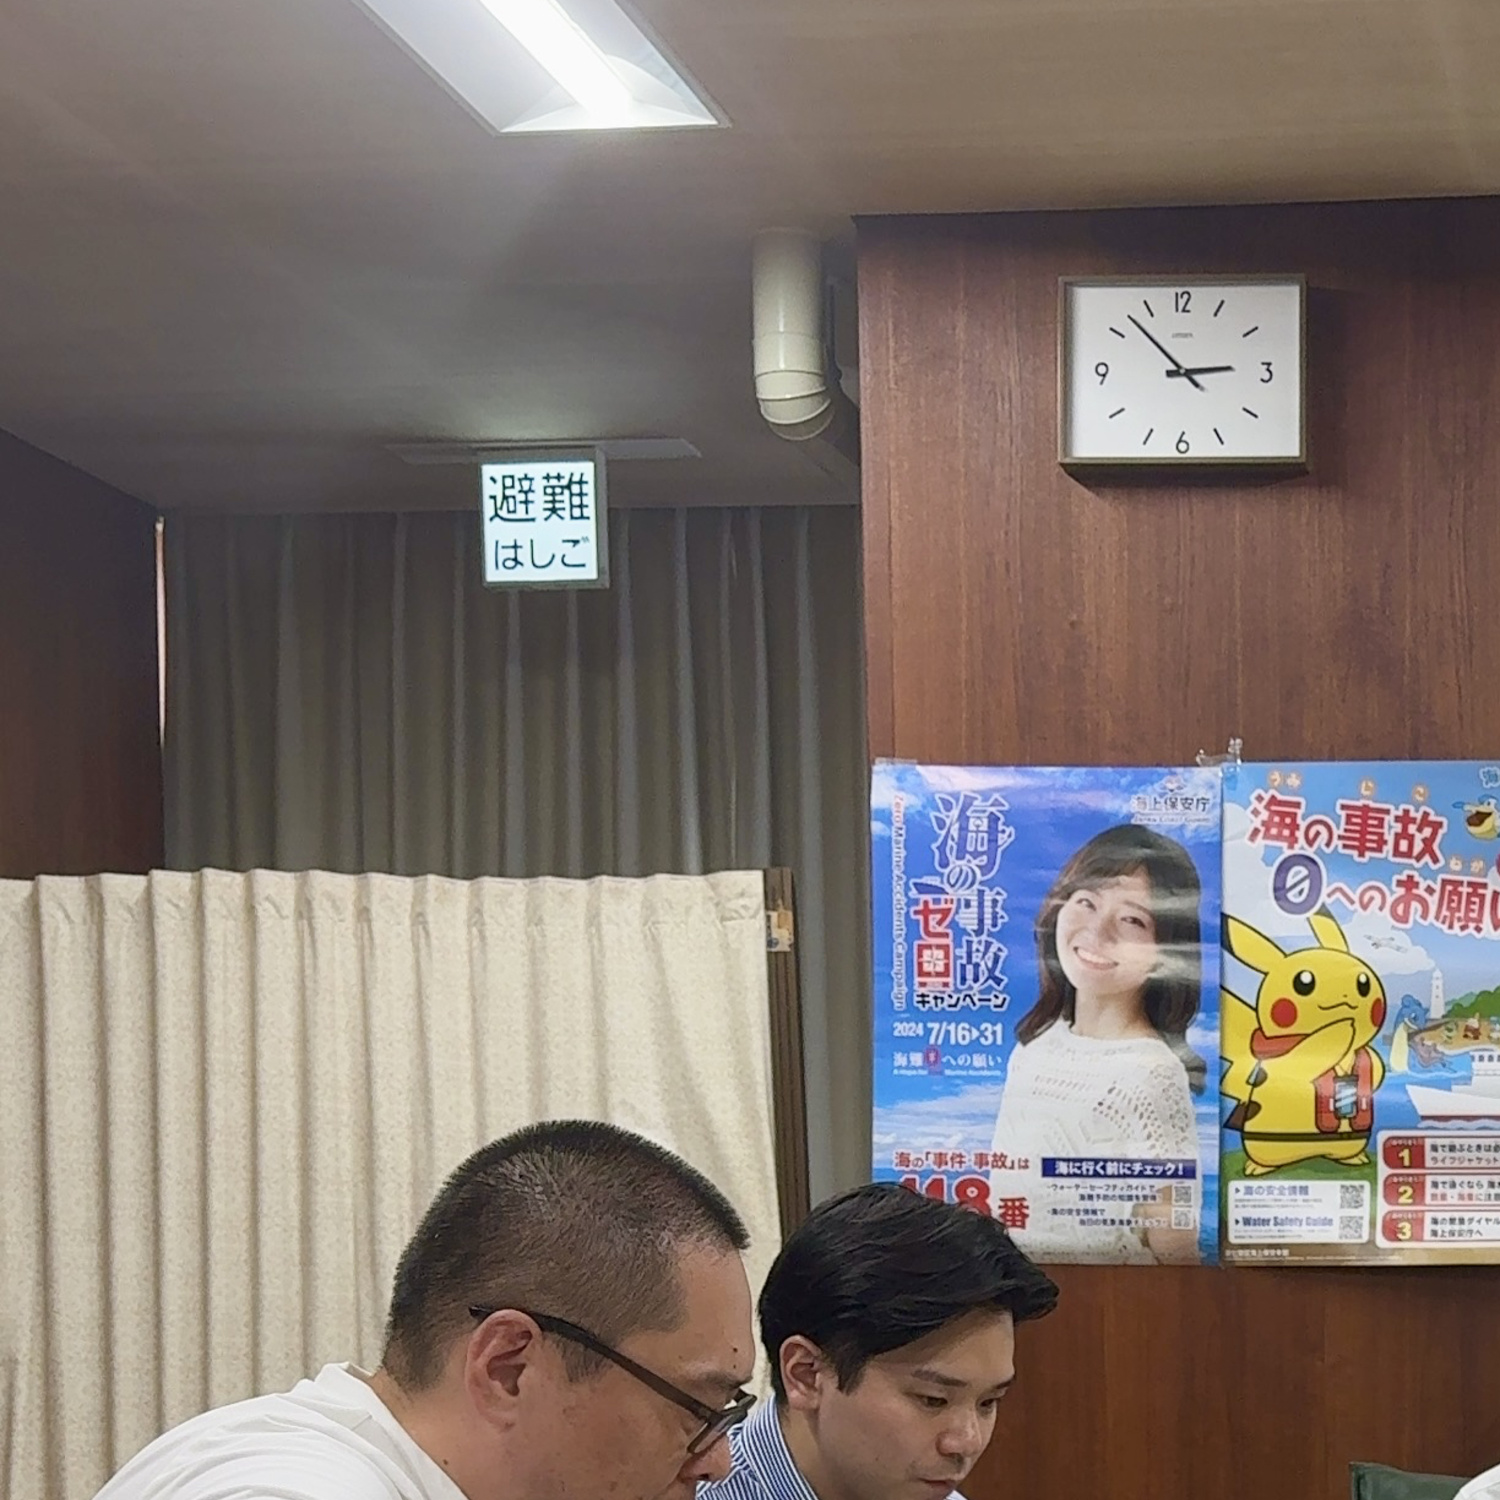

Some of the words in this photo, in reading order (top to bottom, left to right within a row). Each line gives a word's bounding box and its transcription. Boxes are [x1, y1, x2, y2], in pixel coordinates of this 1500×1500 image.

[1174, 290, 1192, 313] 12
[1094, 362, 1109, 385] 9
[1260, 362, 1273, 383] 3
[1175, 431, 1190, 454] 6
[489, 472, 590, 522] 避難
[494, 536, 590, 570] はしご
[1248, 793, 1446, 866] 海の事故
[914, 992, 1007, 1009] キャンペーン
[893, 1022, 924, 1037] 2024
[980, 1022, 1003, 1046] 31
[1399, 1148, 1412, 1167] 1
[1398, 1186, 1414, 1204] 2
[1242, 1216, 1270, 1227] Water
[1396, 1222, 1412, 1240] 3
